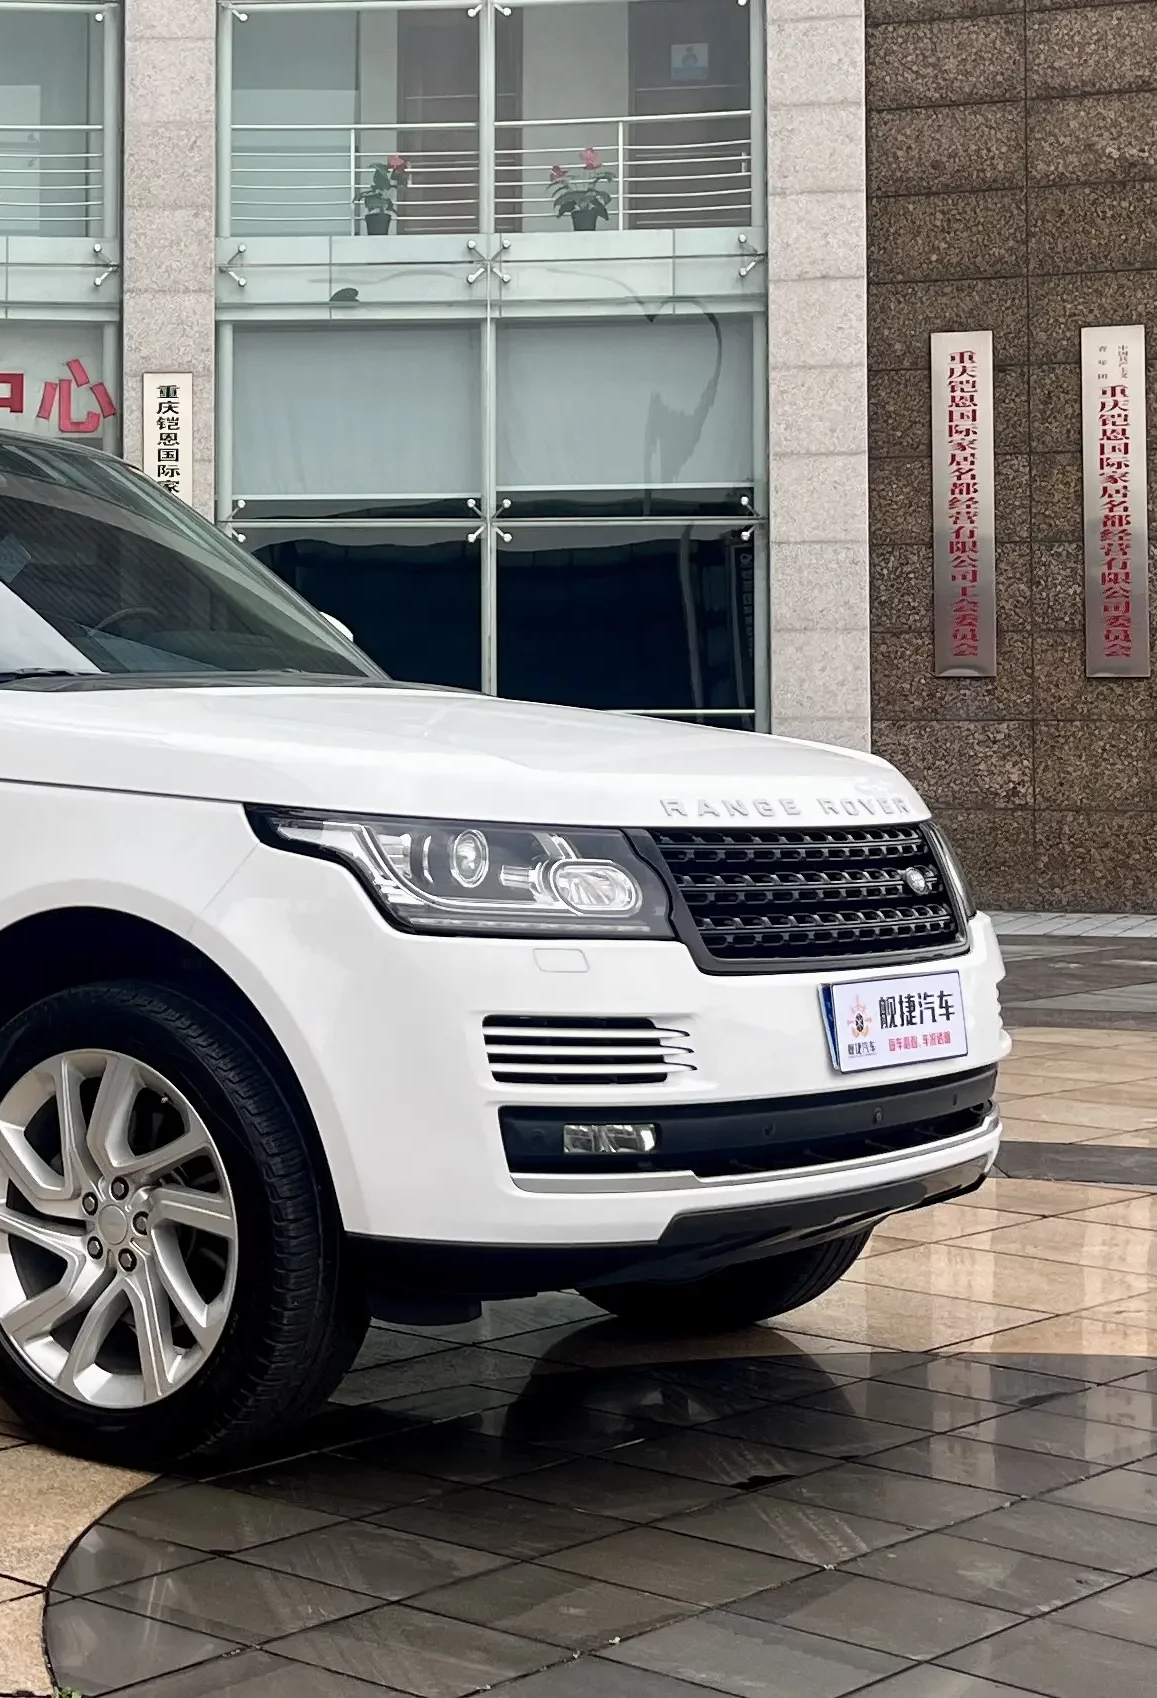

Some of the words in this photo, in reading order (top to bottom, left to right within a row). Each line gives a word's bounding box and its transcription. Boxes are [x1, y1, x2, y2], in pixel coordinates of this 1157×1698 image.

[659, 798, 801, 817] RANGE
[816, 797, 912, 816] ROVER
[878, 990, 956, 1030] 舰捷汽车
